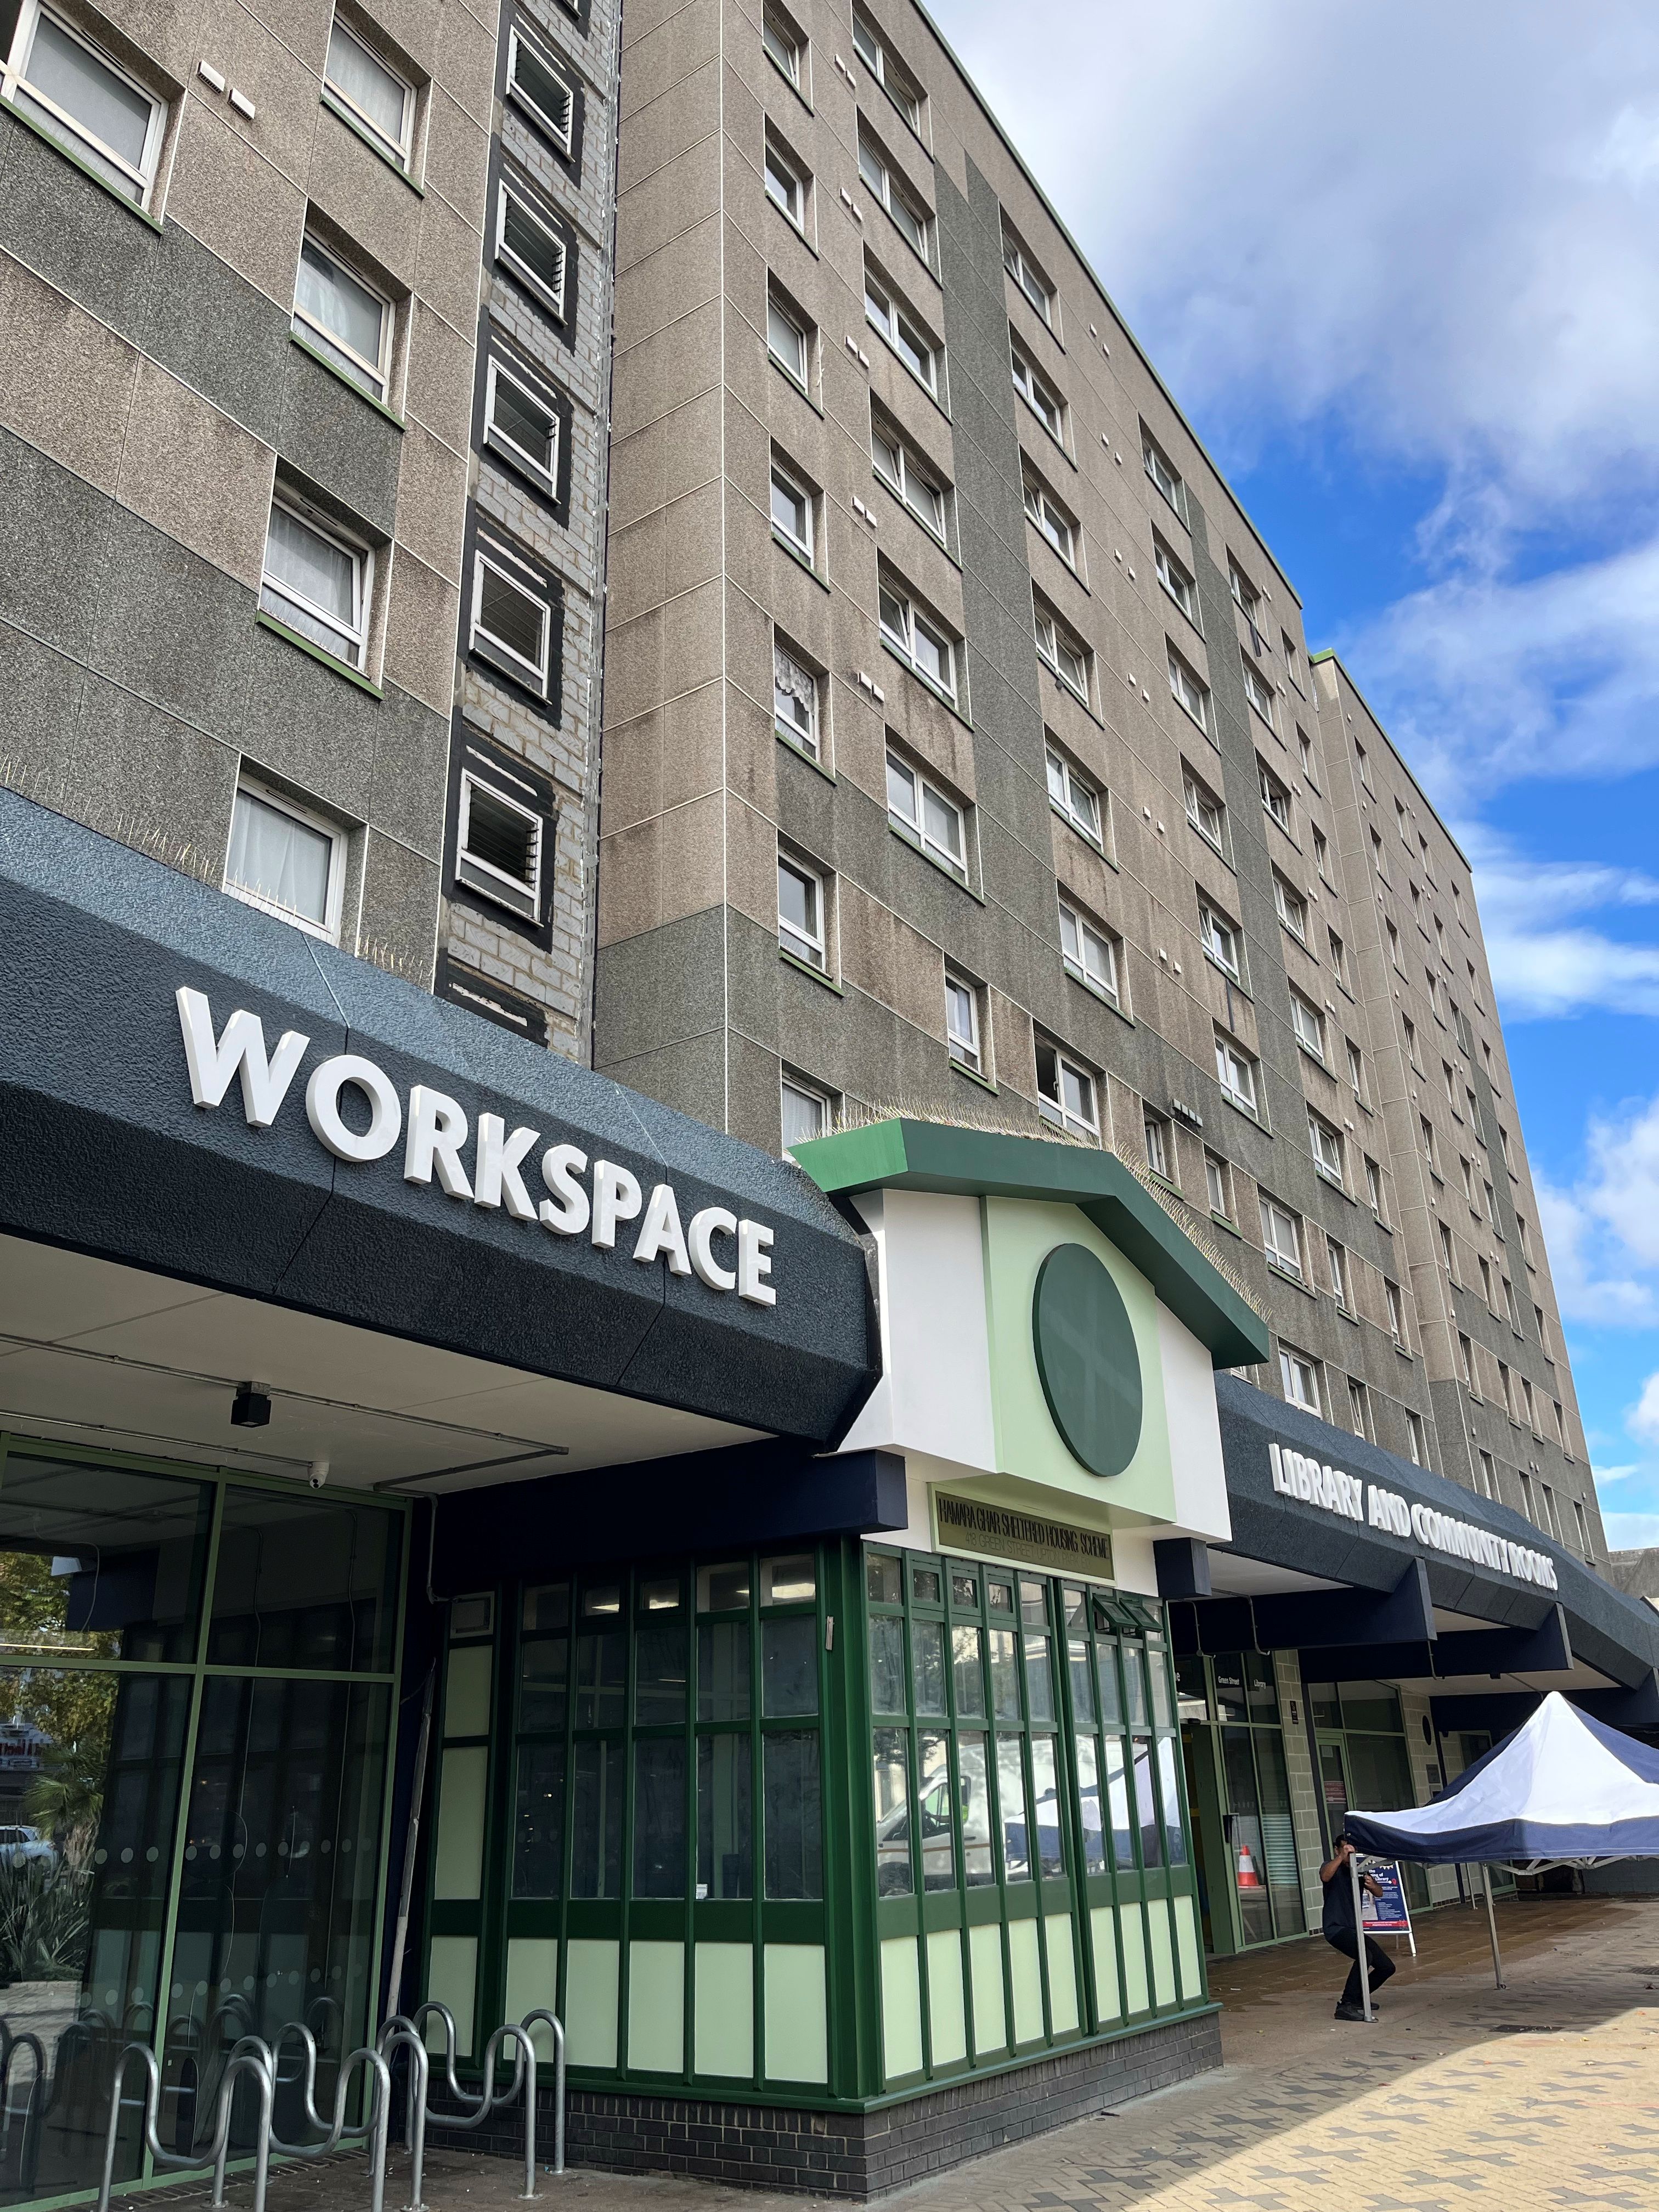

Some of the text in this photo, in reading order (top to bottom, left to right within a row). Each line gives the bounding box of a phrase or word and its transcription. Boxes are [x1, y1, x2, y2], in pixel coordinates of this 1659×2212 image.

[176, 986, 776, 1306] WORKSPACE
[939, 1498, 1110, 1559] HAMARA GHAR SHELTERED HOUSING SCHEME
[965, 1531, 977, 1546] 418
[979, 1534, 1005, 1551] GREEN
[1007, 1540, 1034, 1558] STREET
[1036, 1547, 1060, 1564] UPTON
[1268, 1443, 1558, 1591] LIBRARY AND COMMUNITY ROOMS
[1218, 1676, 1266, 1689] Green Street Library
